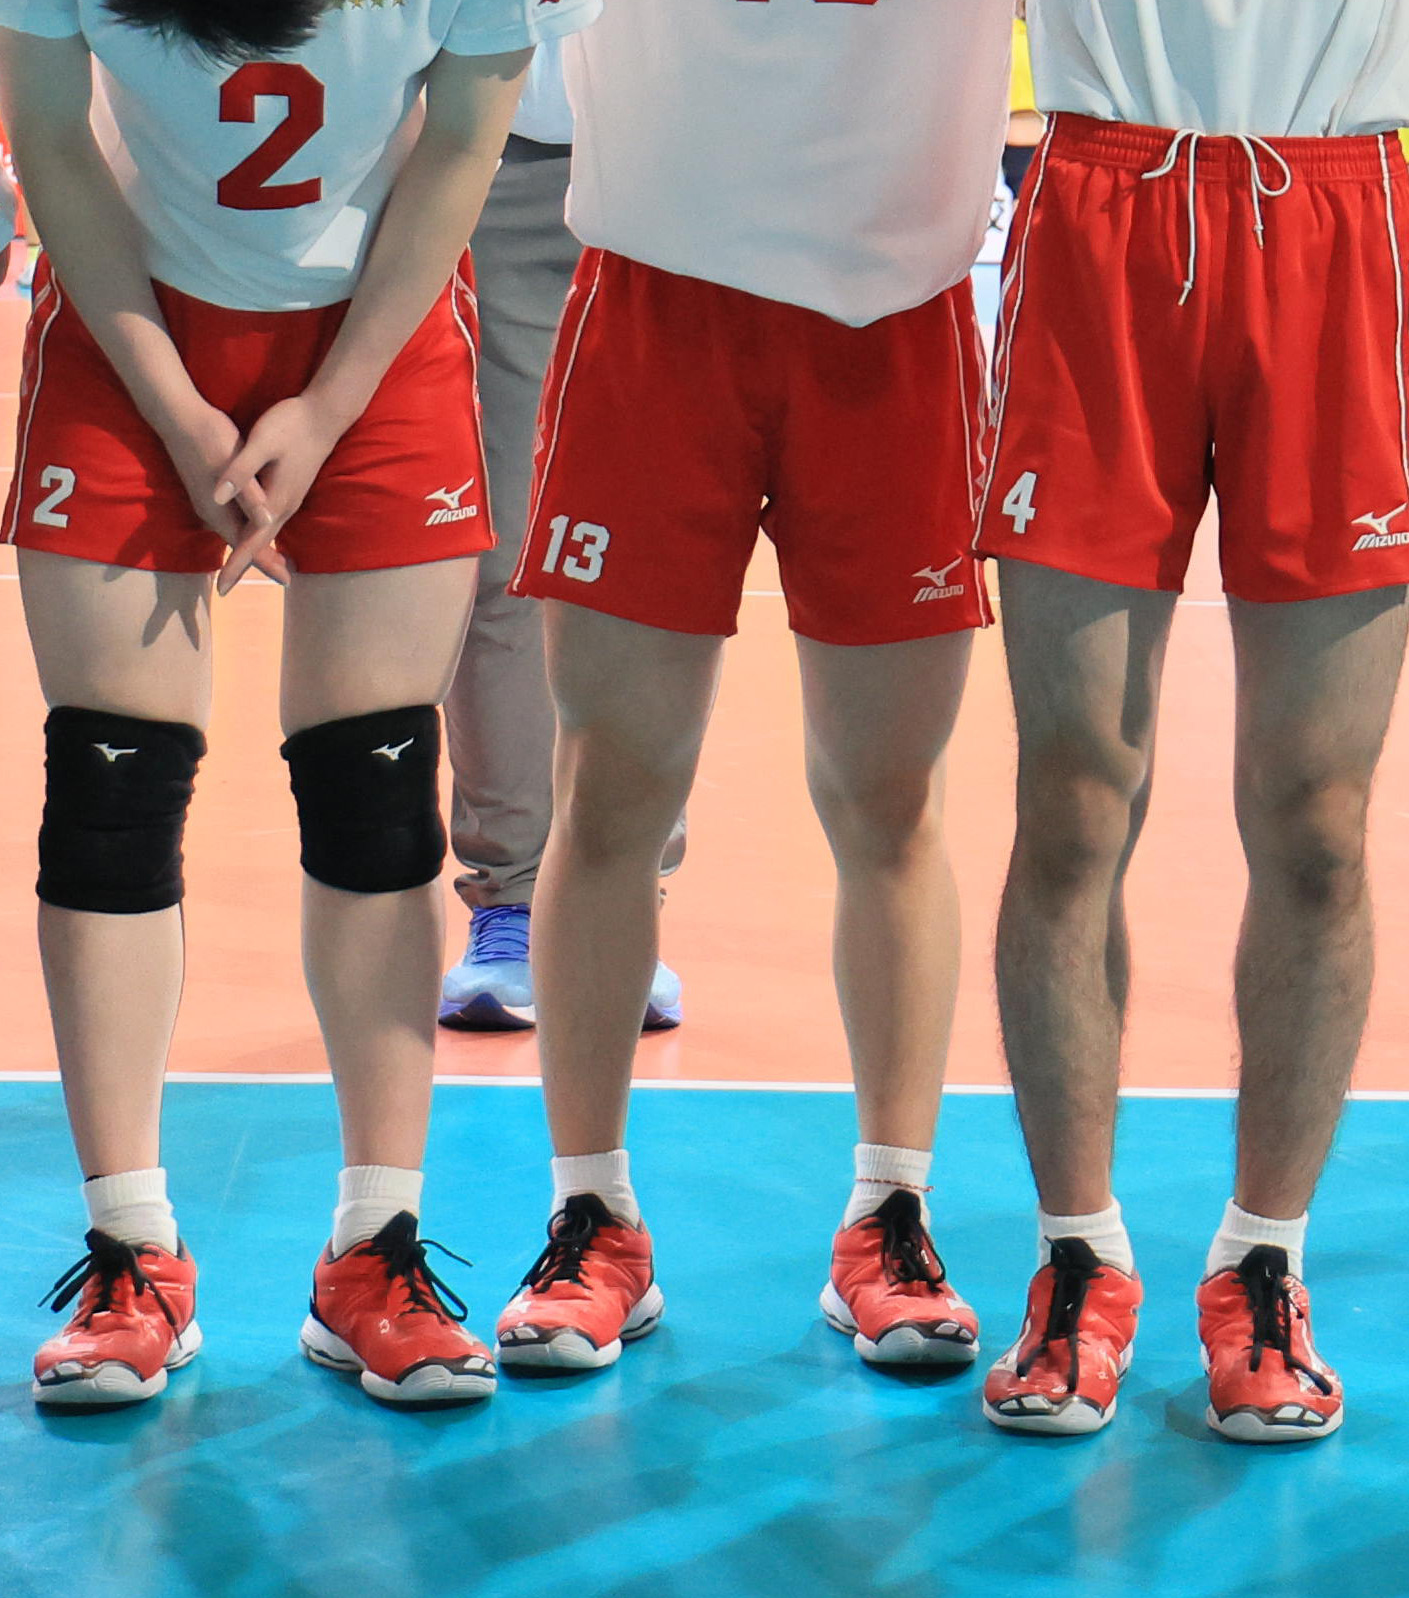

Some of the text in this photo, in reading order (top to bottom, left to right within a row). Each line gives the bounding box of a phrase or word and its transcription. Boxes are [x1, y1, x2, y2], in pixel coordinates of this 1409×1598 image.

[217, 61, 325, 210] 2
[33, 464, 76, 528] 2
[425, 505, 478, 527] MIZUNO
[1001, 470, 1037, 535] 4
[541, 514, 611, 584] 13
